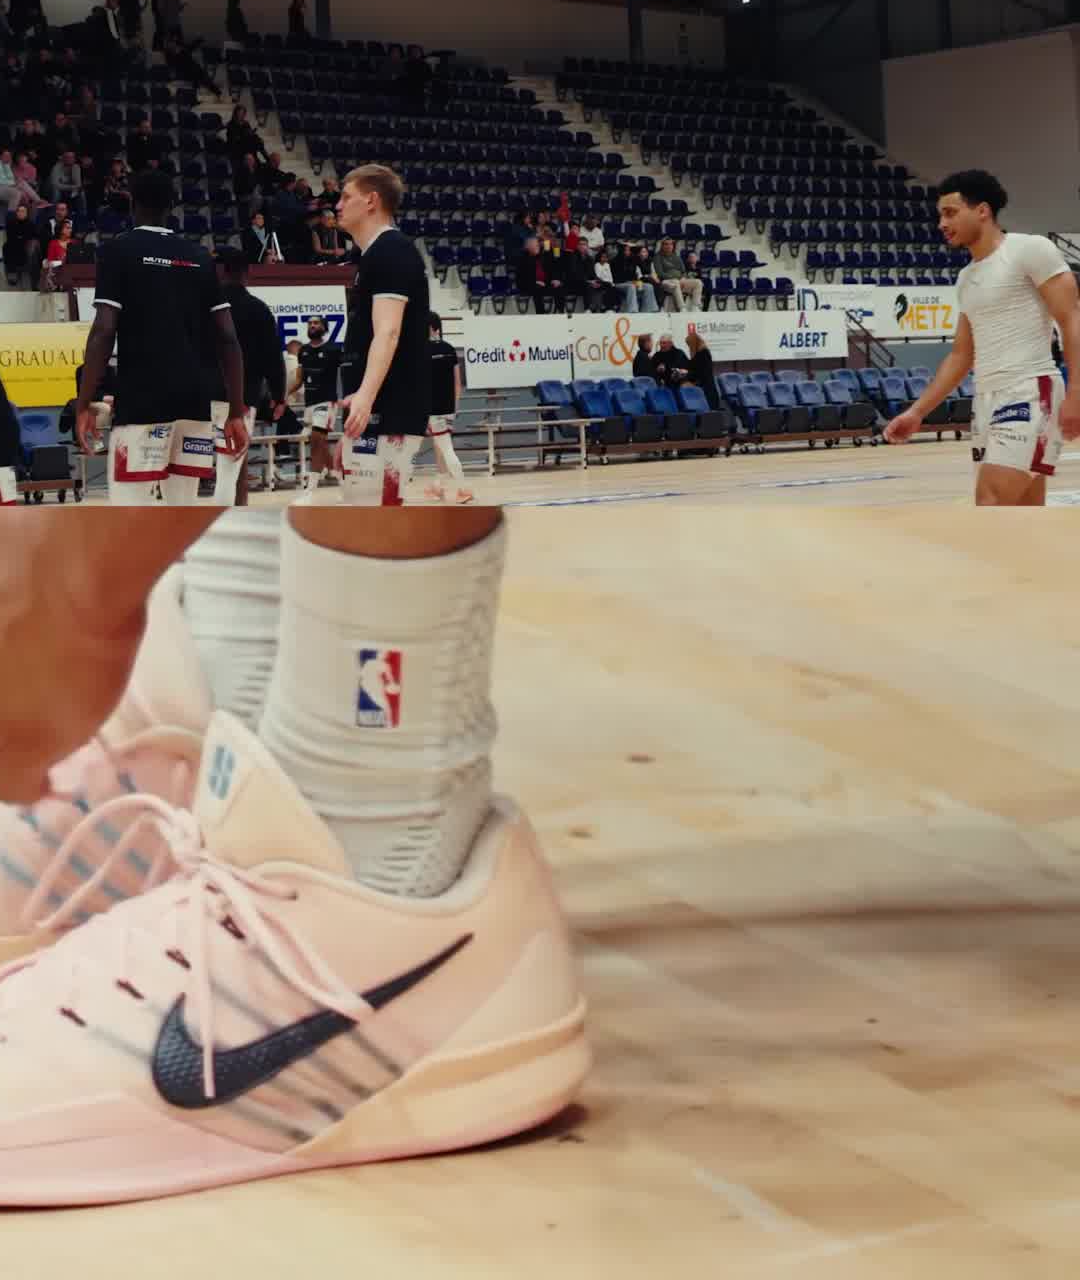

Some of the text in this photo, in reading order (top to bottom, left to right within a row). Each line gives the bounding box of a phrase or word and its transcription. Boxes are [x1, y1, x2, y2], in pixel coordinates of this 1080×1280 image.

[899, 305, 953, 331] METZ
[779, 332, 828, 348] ALBERT
[467, 346, 569, 364] Crédit Mutuel
